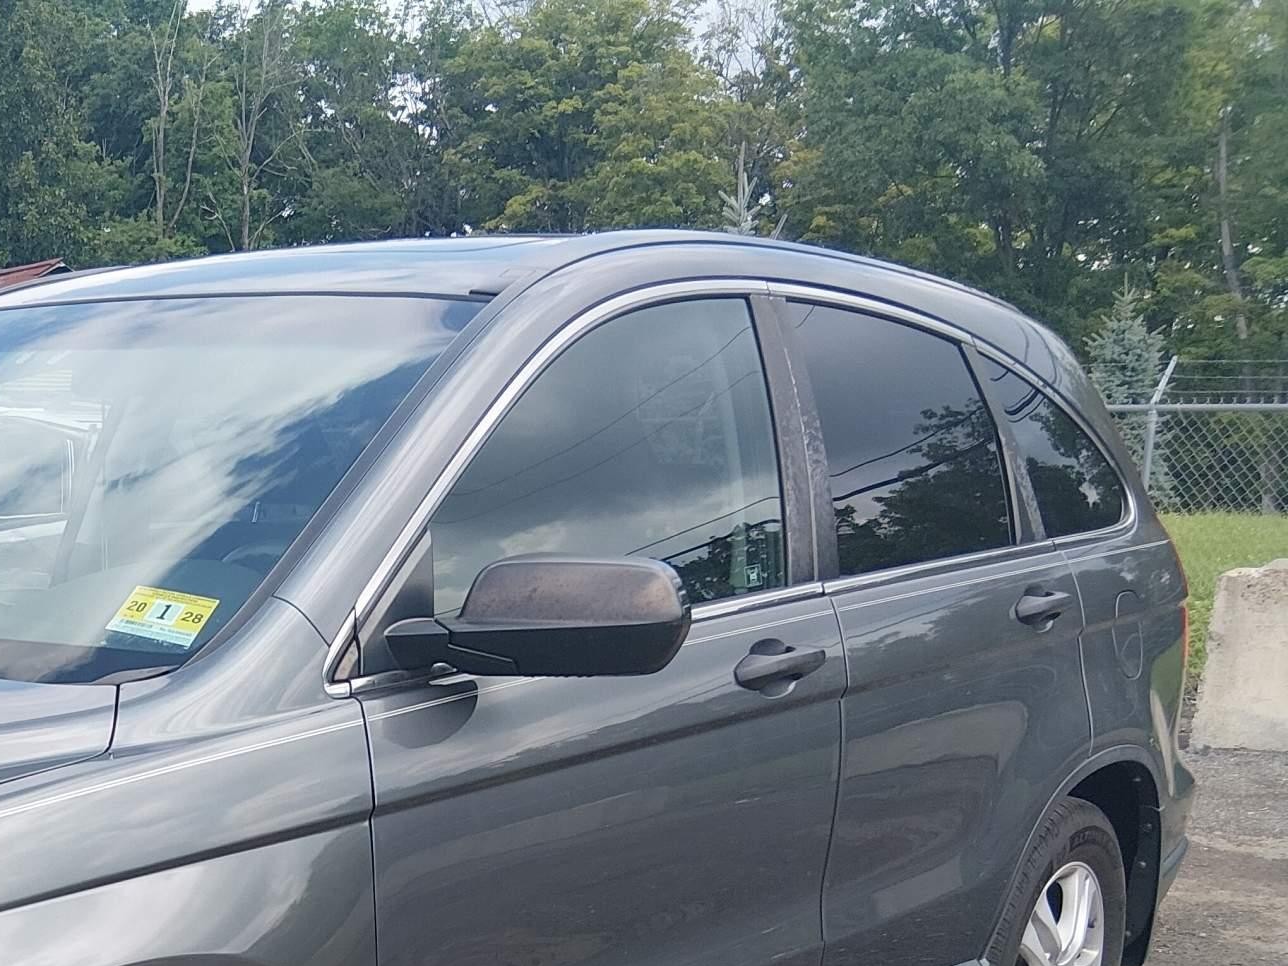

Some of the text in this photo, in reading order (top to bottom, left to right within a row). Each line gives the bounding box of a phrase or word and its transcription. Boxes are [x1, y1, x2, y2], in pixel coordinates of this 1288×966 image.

[126, 600, 204, 624] 20 1 28
